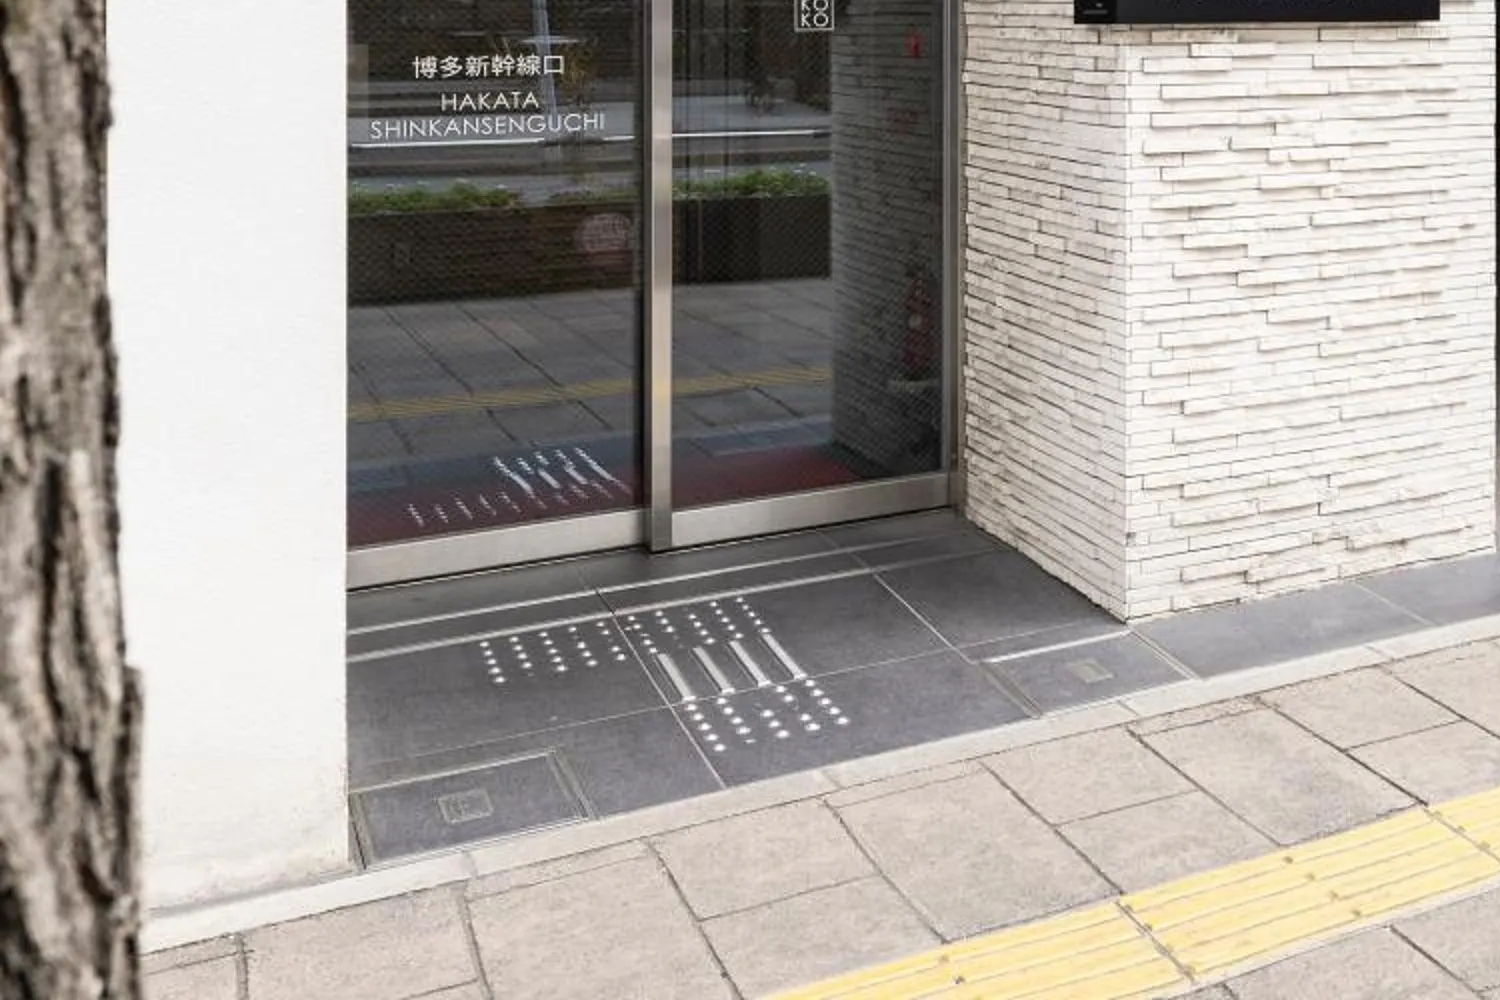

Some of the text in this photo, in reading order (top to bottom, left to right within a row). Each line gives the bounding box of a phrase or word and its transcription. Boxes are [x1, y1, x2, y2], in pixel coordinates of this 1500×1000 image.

[412, 54, 564, 79] 博多新幹線口
[441, 91, 539, 112] HAKATA
[370, 112, 606, 140] SHINKANSENGUCHI
